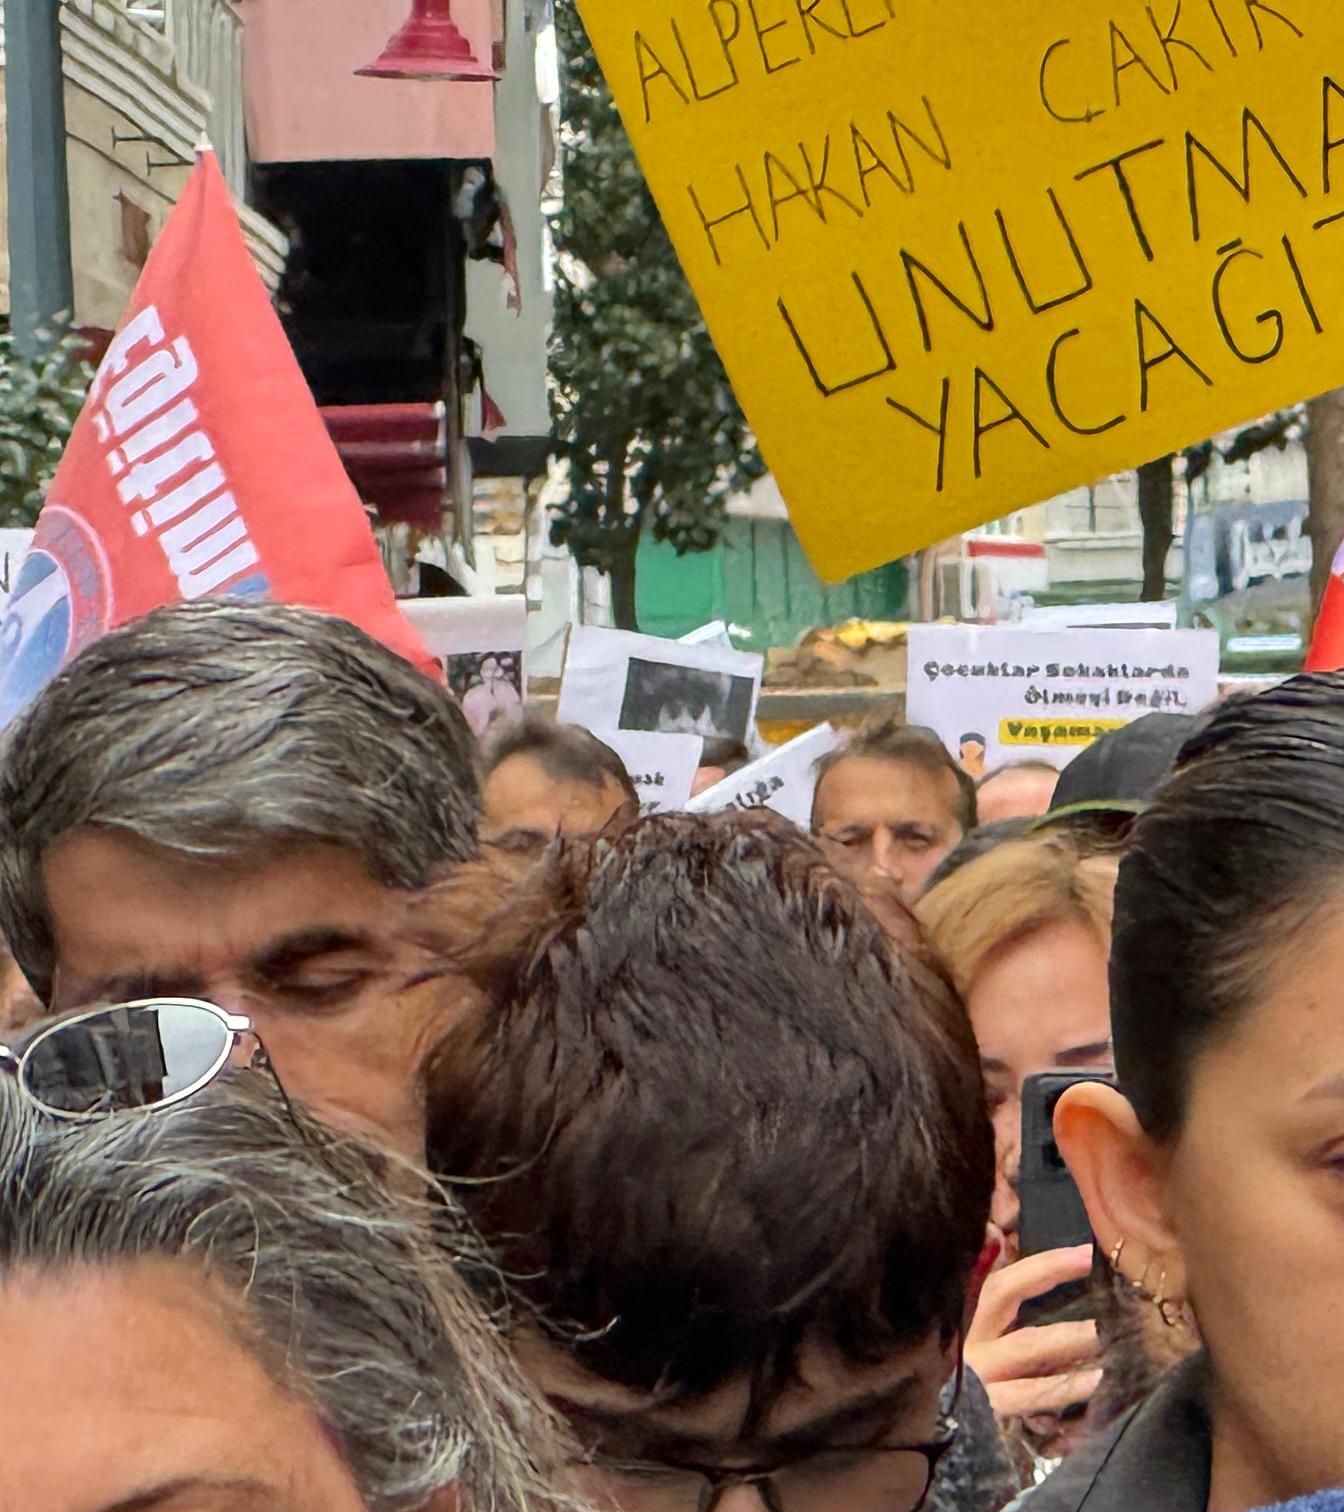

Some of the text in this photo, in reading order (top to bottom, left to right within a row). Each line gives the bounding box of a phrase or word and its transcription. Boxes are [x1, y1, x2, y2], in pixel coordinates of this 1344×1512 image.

[687, 95, 951, 266] HAKAN
[923, 660, 1189, 681] Çocuklar Sokaklarda
